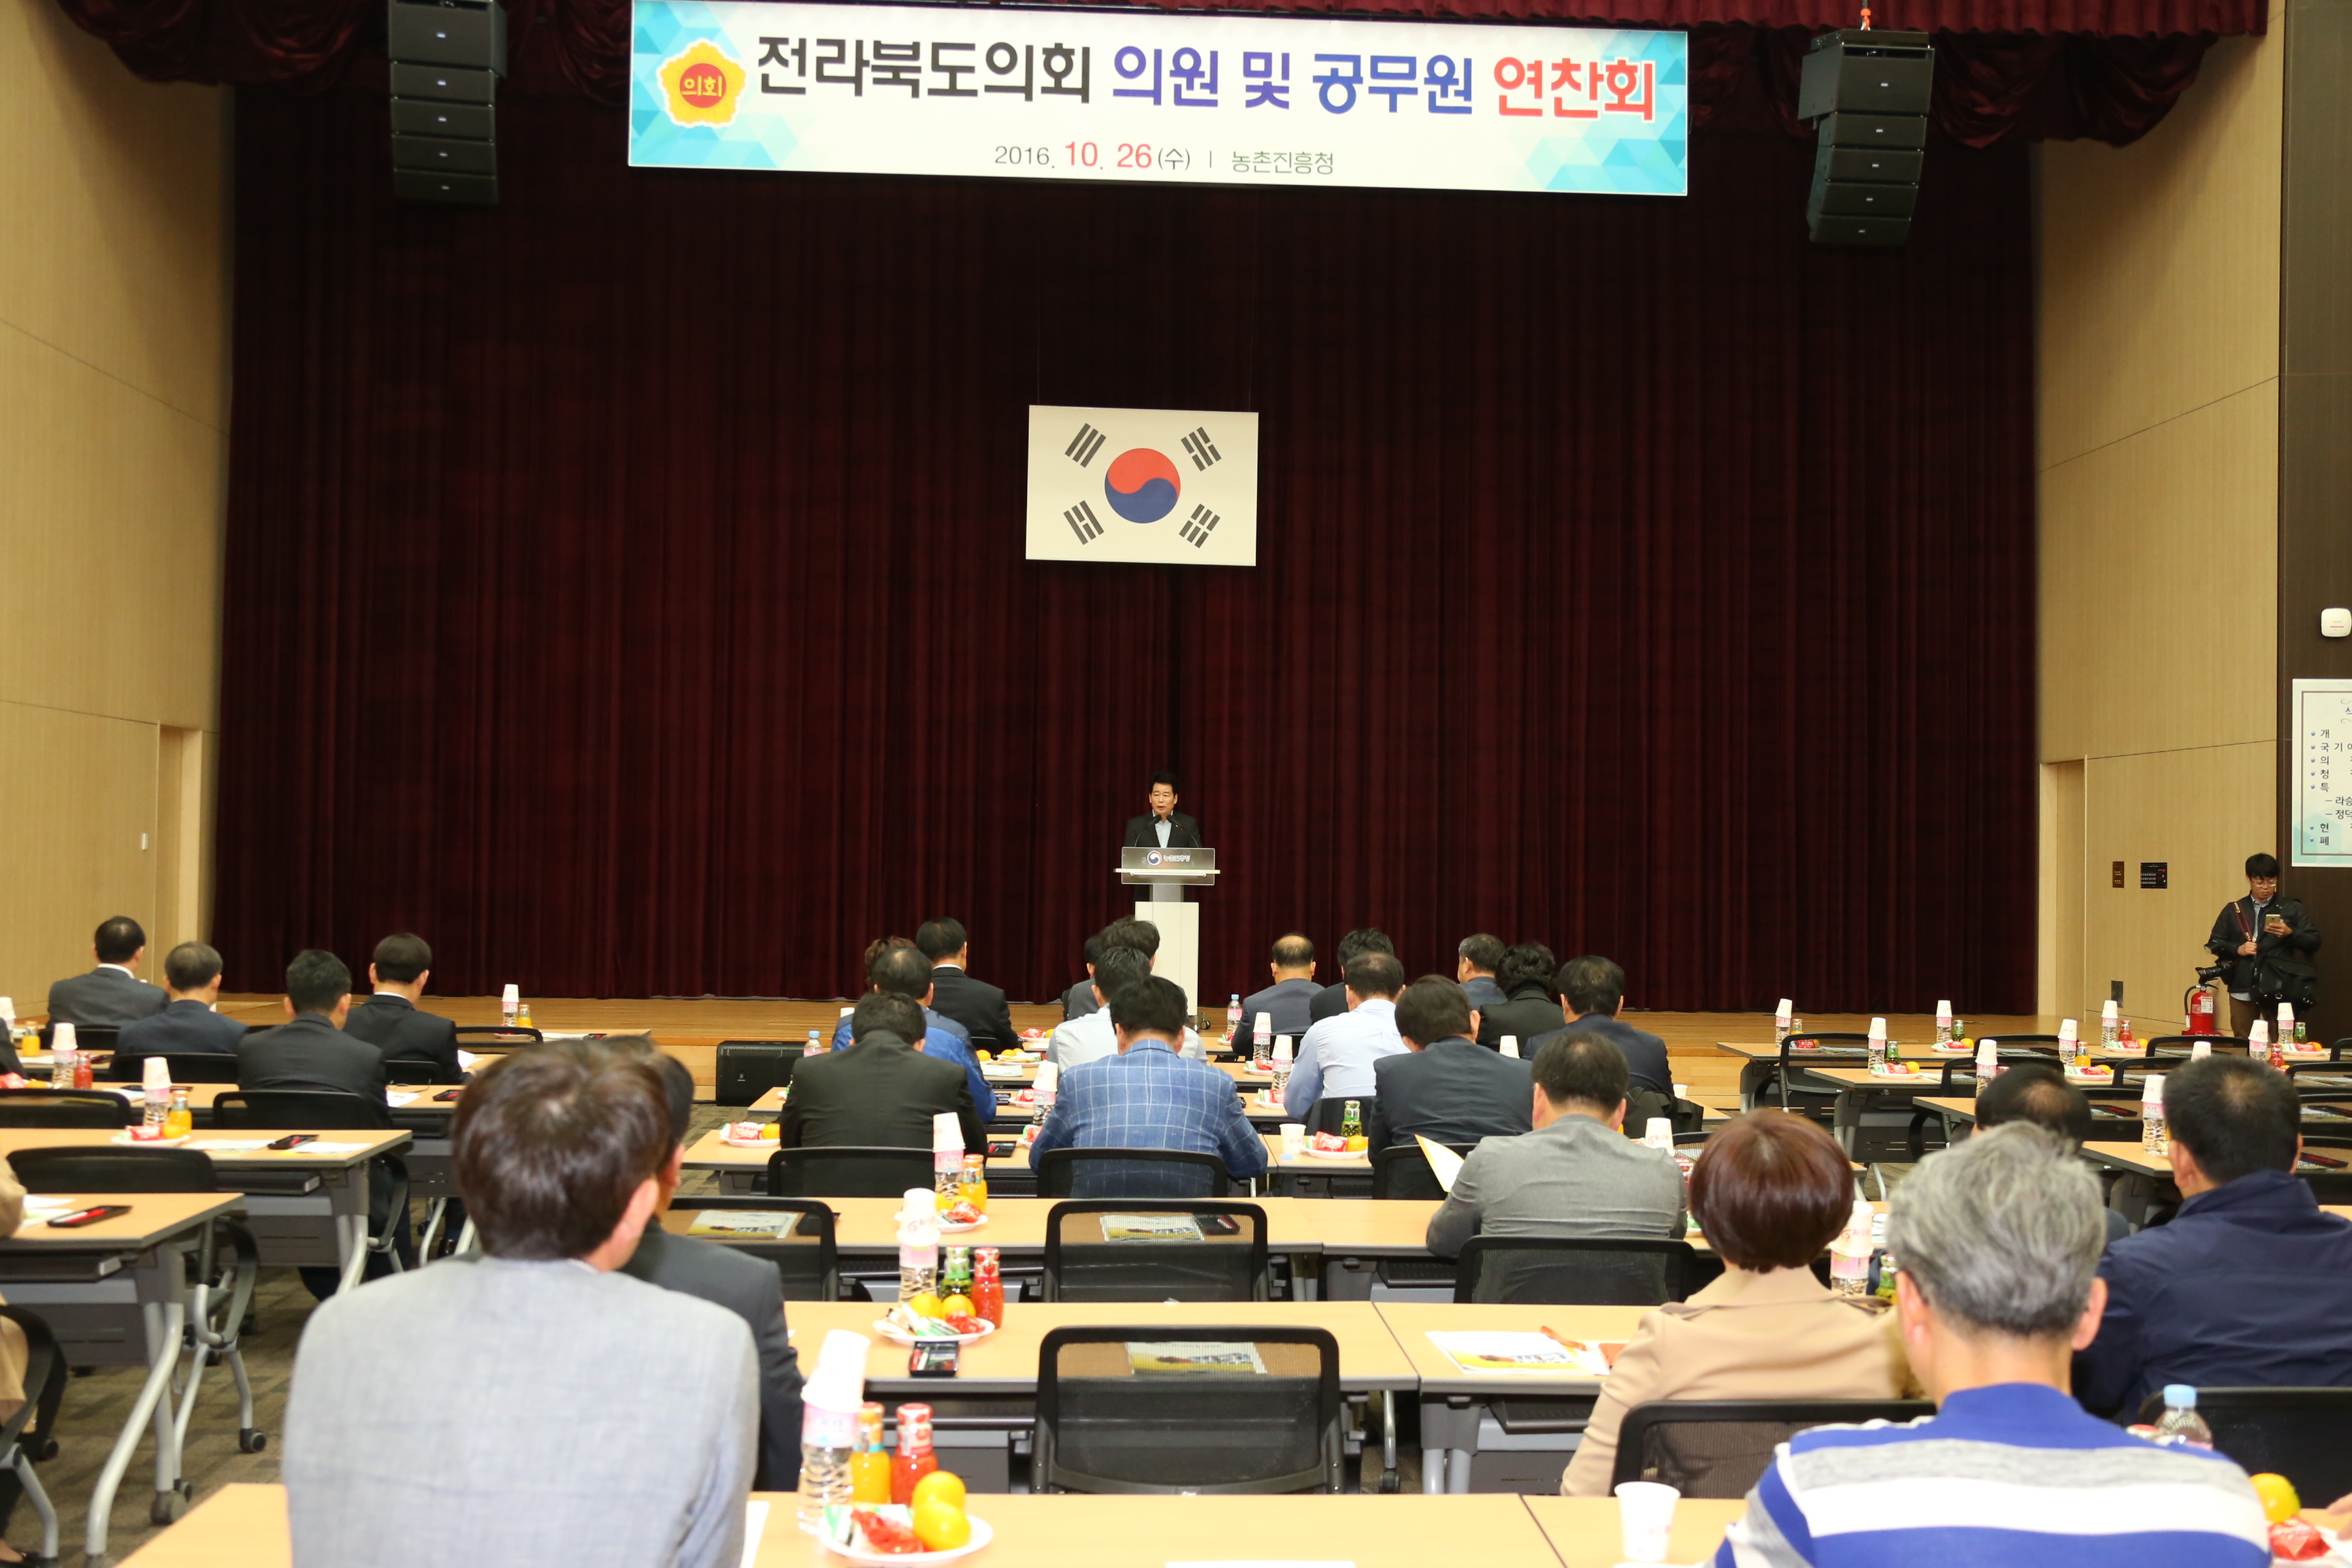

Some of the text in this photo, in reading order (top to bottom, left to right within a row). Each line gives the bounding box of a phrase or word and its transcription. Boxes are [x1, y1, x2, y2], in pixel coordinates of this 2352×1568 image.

[758, 37, 1652, 120] 전라북도의회 의원 및 공무원 연찬회
[681, 76, 723, 97] 의회
[1231, 150, 1334, 175] 농촌진흥청
[2320, 729, 2330, 738] 개
[2320, 755, 2329, 766] 의
[2320, 769, 2329, 779] 청
[2320, 783, 2329, 793] 특
[2320, 823, 2329, 833] 현
[2319, 836, 2329, 846] 폐
